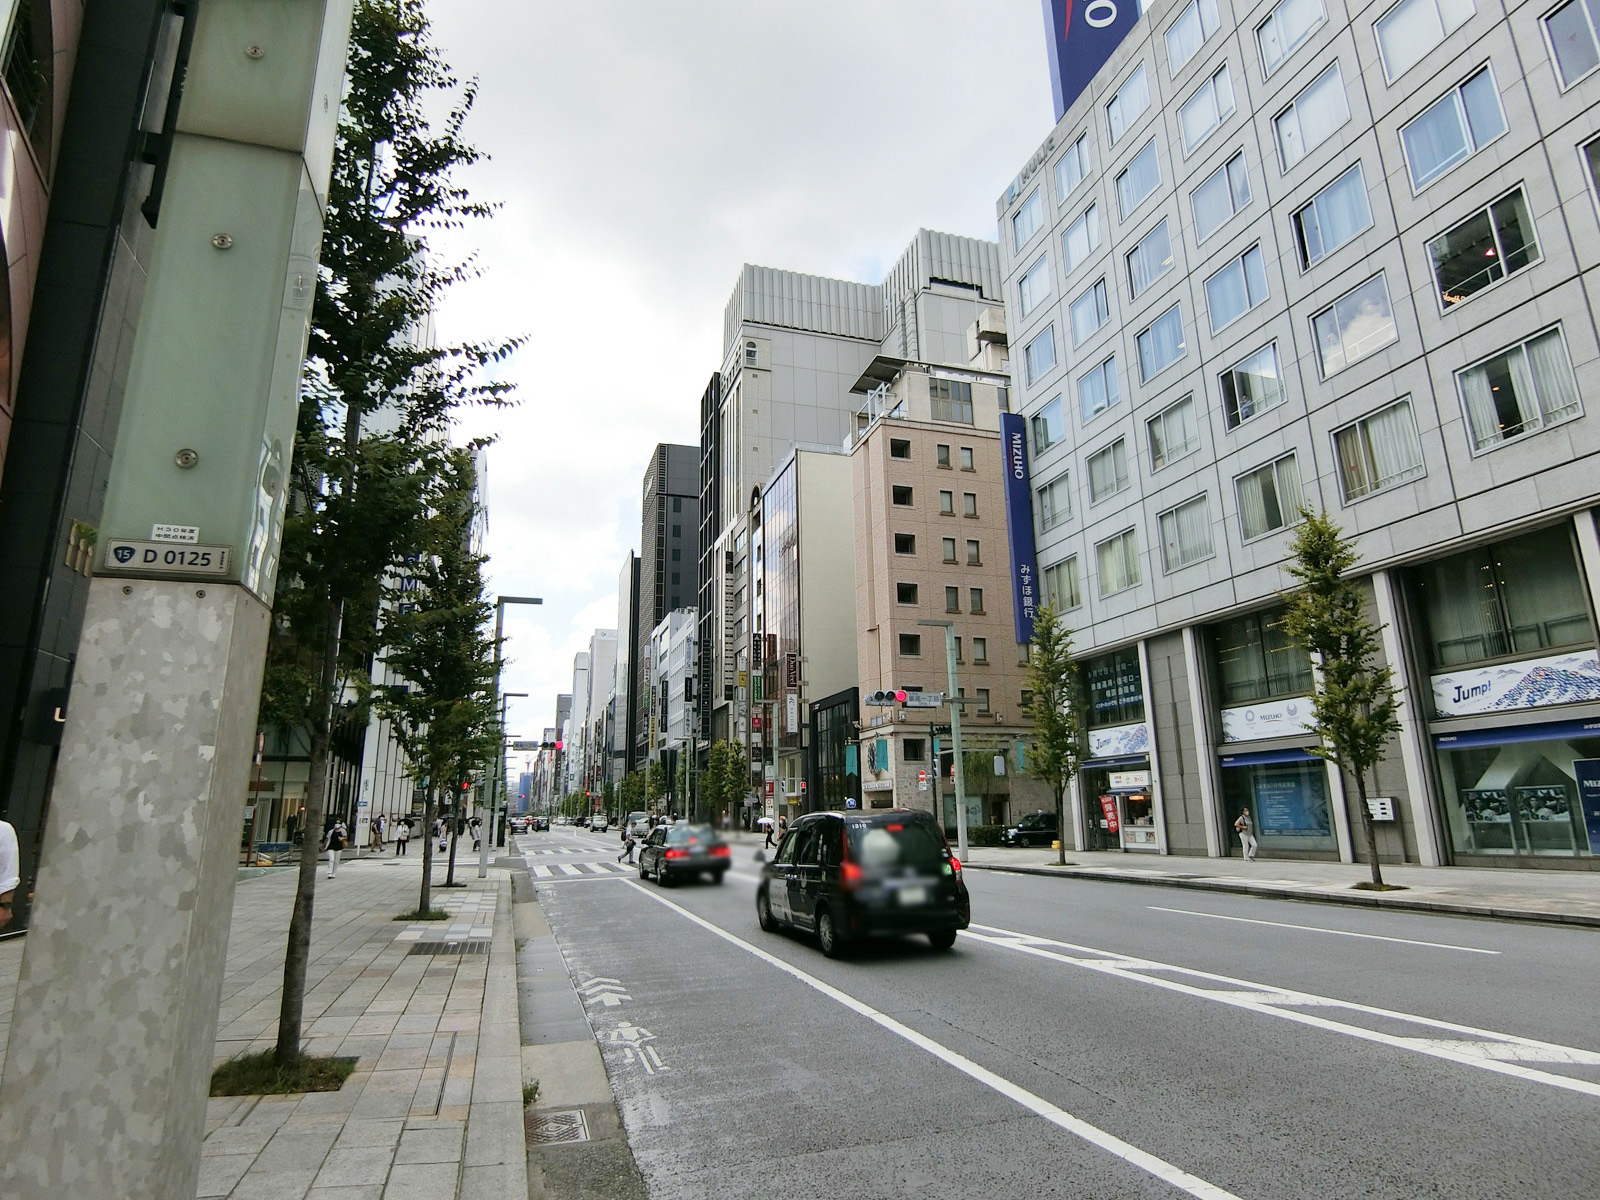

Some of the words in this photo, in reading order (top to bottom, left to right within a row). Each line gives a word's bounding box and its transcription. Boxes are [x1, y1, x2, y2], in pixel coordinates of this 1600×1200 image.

[1012, 432, 1024, 480] MIZUHO
[117, 549, 131, 560] 15
[143, 549, 158, 563] D
[164, 550, 212, 567] 0125
[1020, 564, 1035, 619] みずほ銀行
[1453, 680, 1492, 703] Jump!
[1259, 712, 1283, 721] MIZUHO
